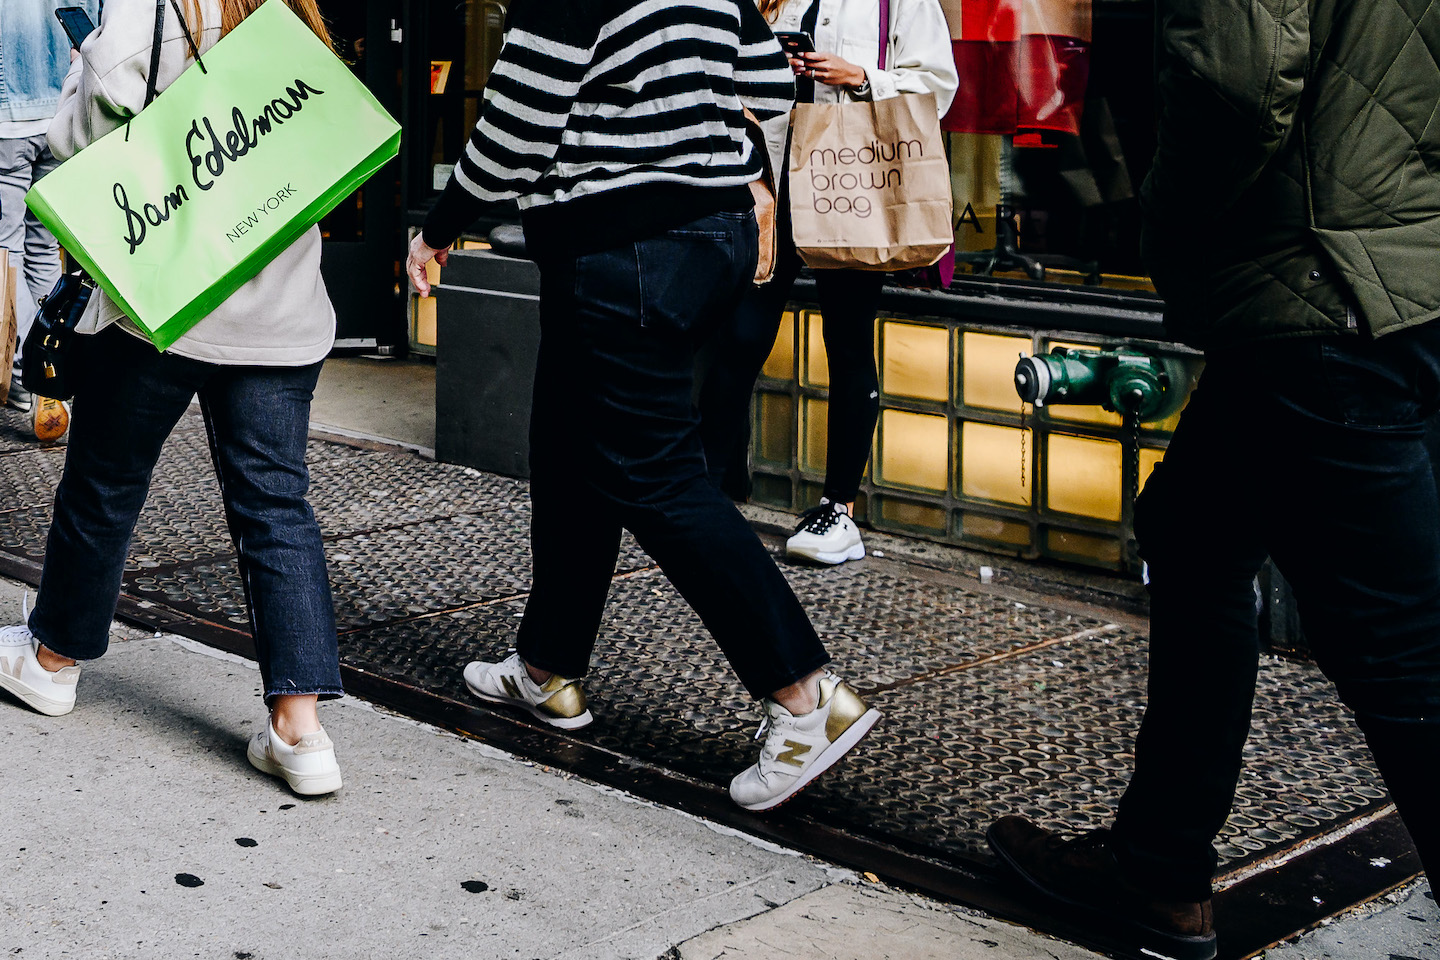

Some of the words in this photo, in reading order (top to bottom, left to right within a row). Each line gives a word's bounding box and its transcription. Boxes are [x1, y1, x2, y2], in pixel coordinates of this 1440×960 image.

[113, 182, 190, 255] Sam
[185, 78, 324, 191] Edelman
[810, 139, 923, 166] medium
[811, 168, 901, 191] brown
[225, 209, 259, 244] NEW
[257, 181, 298, 219] YORK
[812, 191, 872, 219] bag
